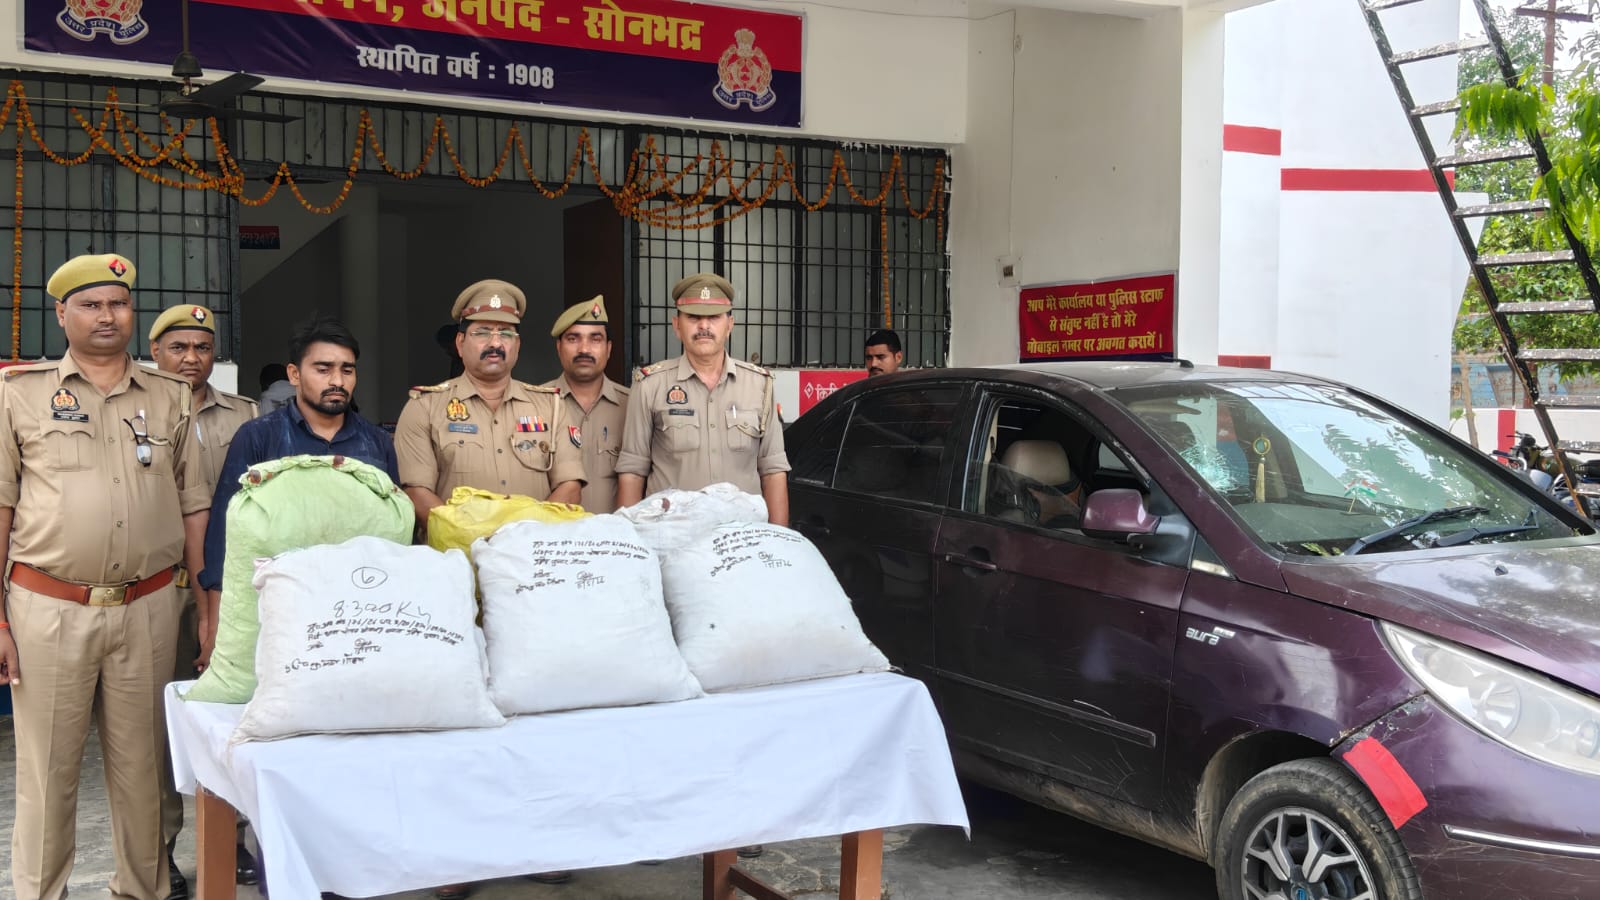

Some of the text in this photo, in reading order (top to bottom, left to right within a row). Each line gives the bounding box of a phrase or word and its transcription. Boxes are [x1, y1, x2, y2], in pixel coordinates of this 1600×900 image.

[582, 0, 705, 51] सोनभद्र
[355, 44, 440, 76] स्थापित
[446, 52, 481, 80] वर्ष
[505, 63, 555, 90] 1908
[1026, 287, 1165, 313] आप मेरे कार्यालय या पुलिस स्टाफ
[1049, 316, 1057, 332] से
[1059, 313, 1082, 336] संतुष्ट
[1111, 311, 1121, 328] तो
[1123, 310, 1137, 328] मेरे
[1026, 337, 1060, 355] मोबाइल
[1083, 338, 1096, 352] पर
[1097, 335, 1127, 352] अवगत
[1186, 627, 1219, 645] aura
